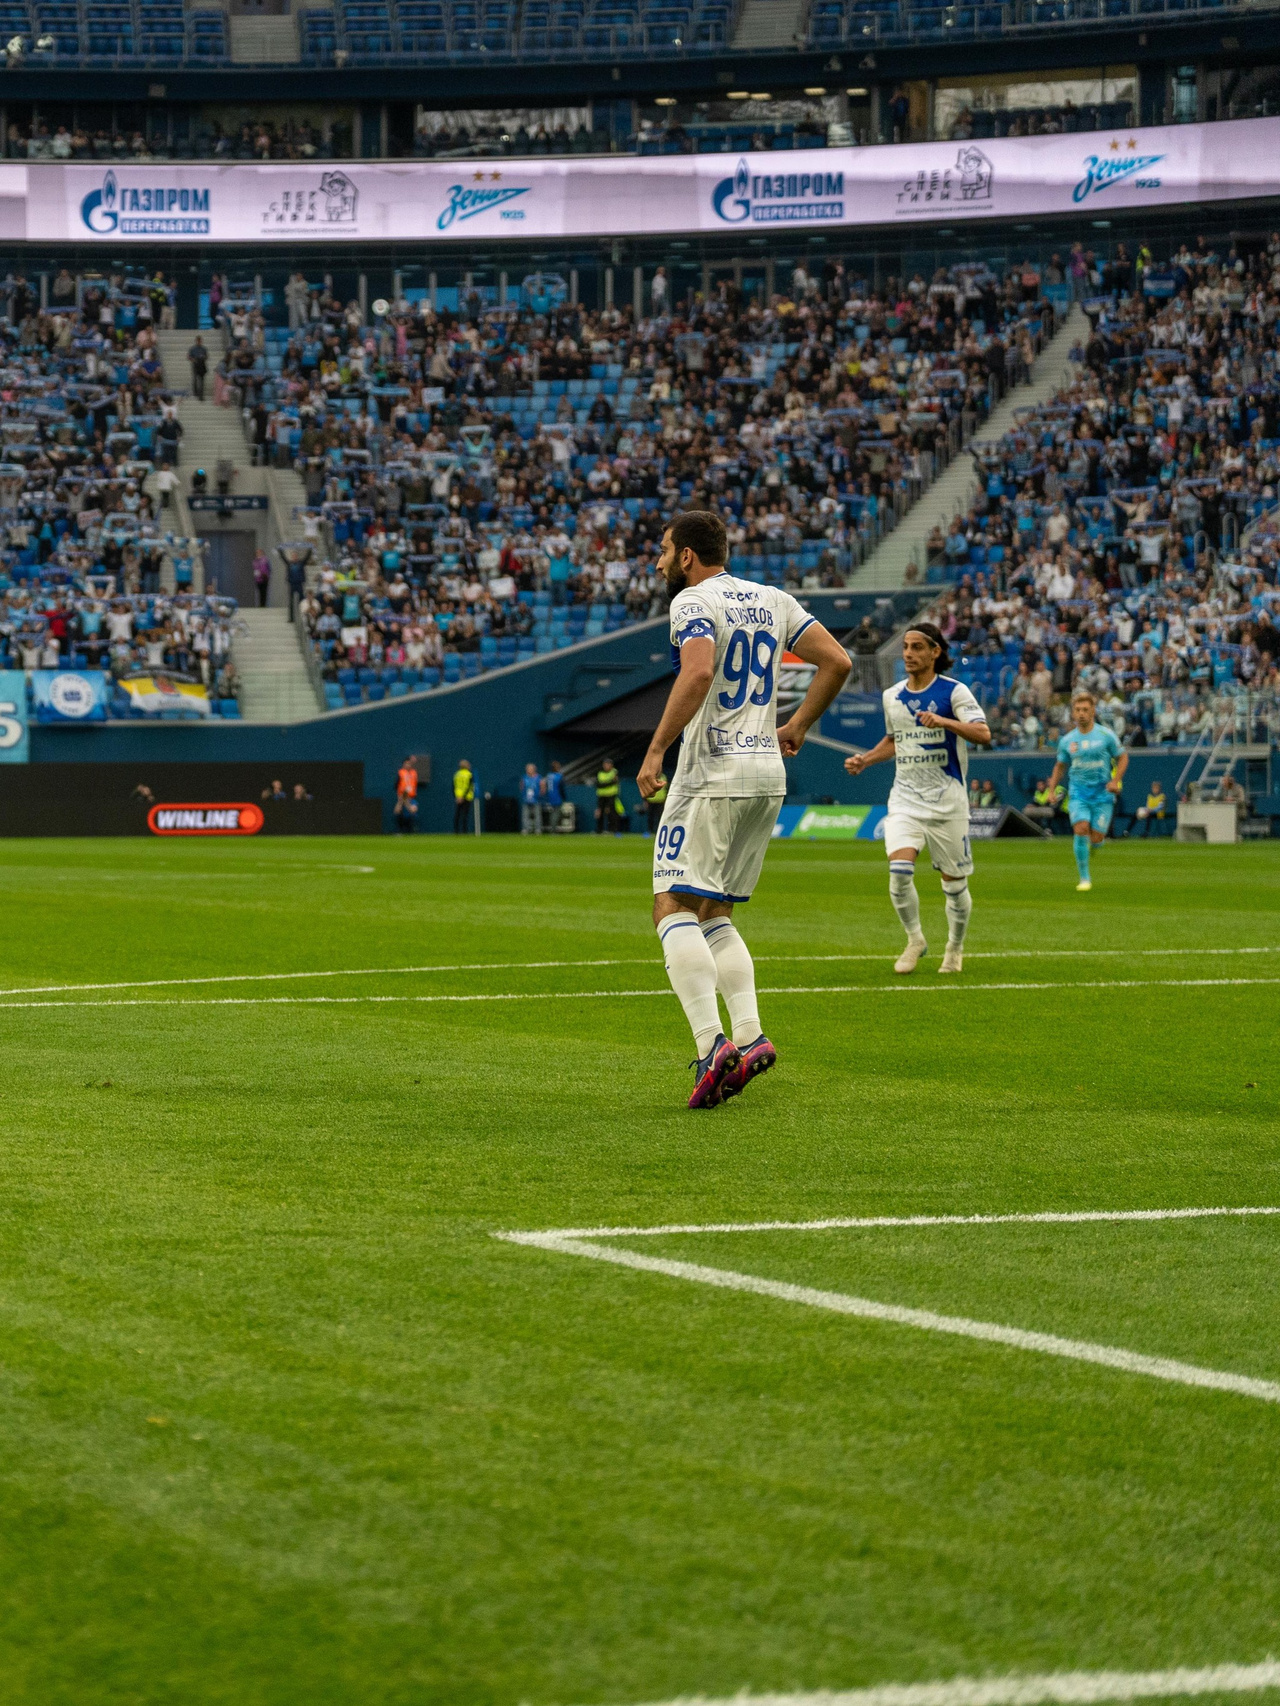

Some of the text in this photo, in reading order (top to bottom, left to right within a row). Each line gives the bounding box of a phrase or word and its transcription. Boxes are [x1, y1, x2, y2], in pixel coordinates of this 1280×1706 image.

[752, 172, 845, 199] ГАЗПРОМ
[1135, 177, 1162, 189] 1925
[120, 187, 210, 212] ГАЗПРОМ
[500, 209, 526, 220] 1925
[753, 202, 844, 220] ПЕРЕРАБОТКА
[121, 218, 209, 233] ПЕРЕРАБОТКА
[718, 629, 778, 710] 99
[905, 730, 944, 740] МАГНИТ
[897, 754, 946, 764] БЕТСИТИ
[157, 809, 240, 829] WINLINE
[657, 825, 686, 861] 99
